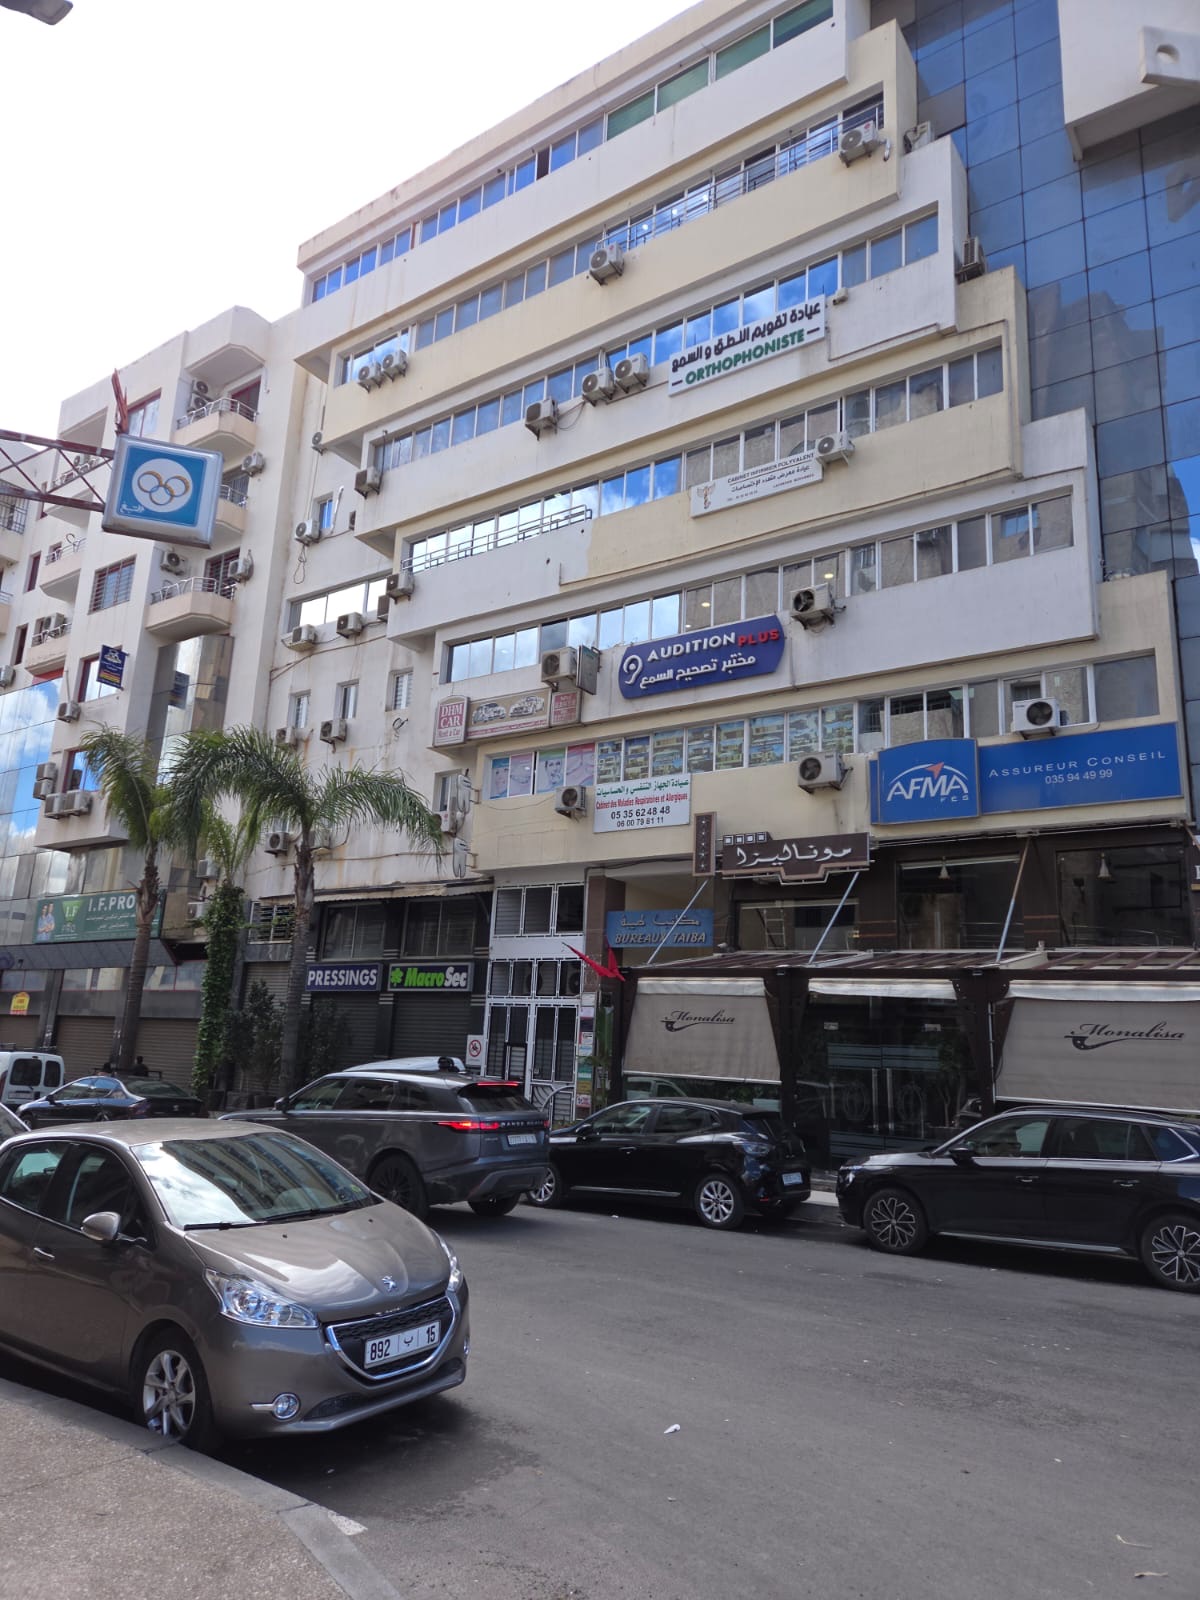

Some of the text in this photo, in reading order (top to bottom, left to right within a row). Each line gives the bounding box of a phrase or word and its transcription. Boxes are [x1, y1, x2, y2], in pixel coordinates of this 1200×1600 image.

[790, 301, 821, 324] عيادة
[751, 313, 787, 342] تقويم
[672, 346, 703, 373] السمع
[684, 328, 805, 385] ORTHOPHONISTE
[777, 453, 815, 469] POLYVALENT
[647, 628, 780, 662] AUDITION PLUS
[639, 652, 757, 689] مختبر تصحيح السمع
[441, 703, 463, 718] DHM
[440, 715, 461, 729] CAR
[988, 751, 1166, 778] ASSUREUR CONSEIL
[1045, 768, 1113, 785] 035 94 49 99
[886, 774, 970, 802] AFMA
[611, 805, 671, 820] 05 35 62 48 48
[617, 820, 625, 828] 06
[626, 819, 634, 827] 00
[657, 816, 664, 824] 11
[615, 932, 706, 945] BUREAUX TAIBA
[307, 969, 377, 986] PRESSINGS
[404, 966, 467, 987] MacroSec
[665, 1008, 736, 1023] Monalisa
[1070, 1021, 1185, 1039] Monalisa
[370, 1339, 391, 1361] 892
[426, 1325, 436, 1344] 15
